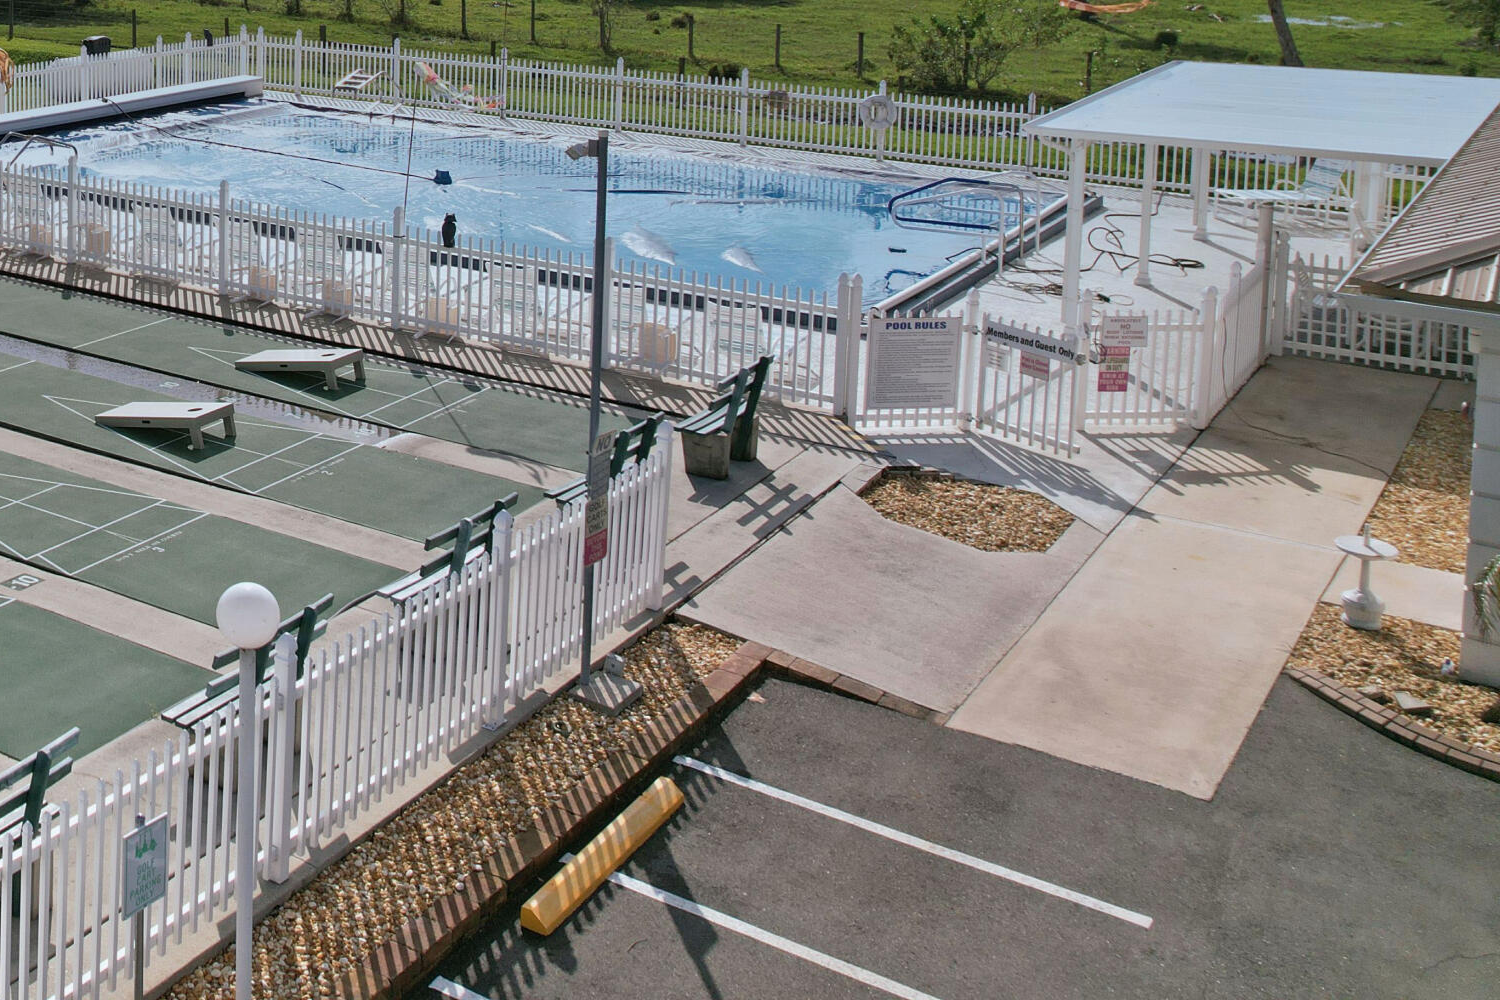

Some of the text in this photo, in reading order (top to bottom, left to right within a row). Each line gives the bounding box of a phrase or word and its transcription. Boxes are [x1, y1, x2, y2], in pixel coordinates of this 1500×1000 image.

[885, 321, 948, 330] POOL RULES
[987, 326, 1075, 360] Members and Guest Only
[596, 435, 611, 451] NO
[136, 857, 156, 876] GOLF
[130, 873, 161, 900] PARKING
[136, 867, 156, 887] CART
